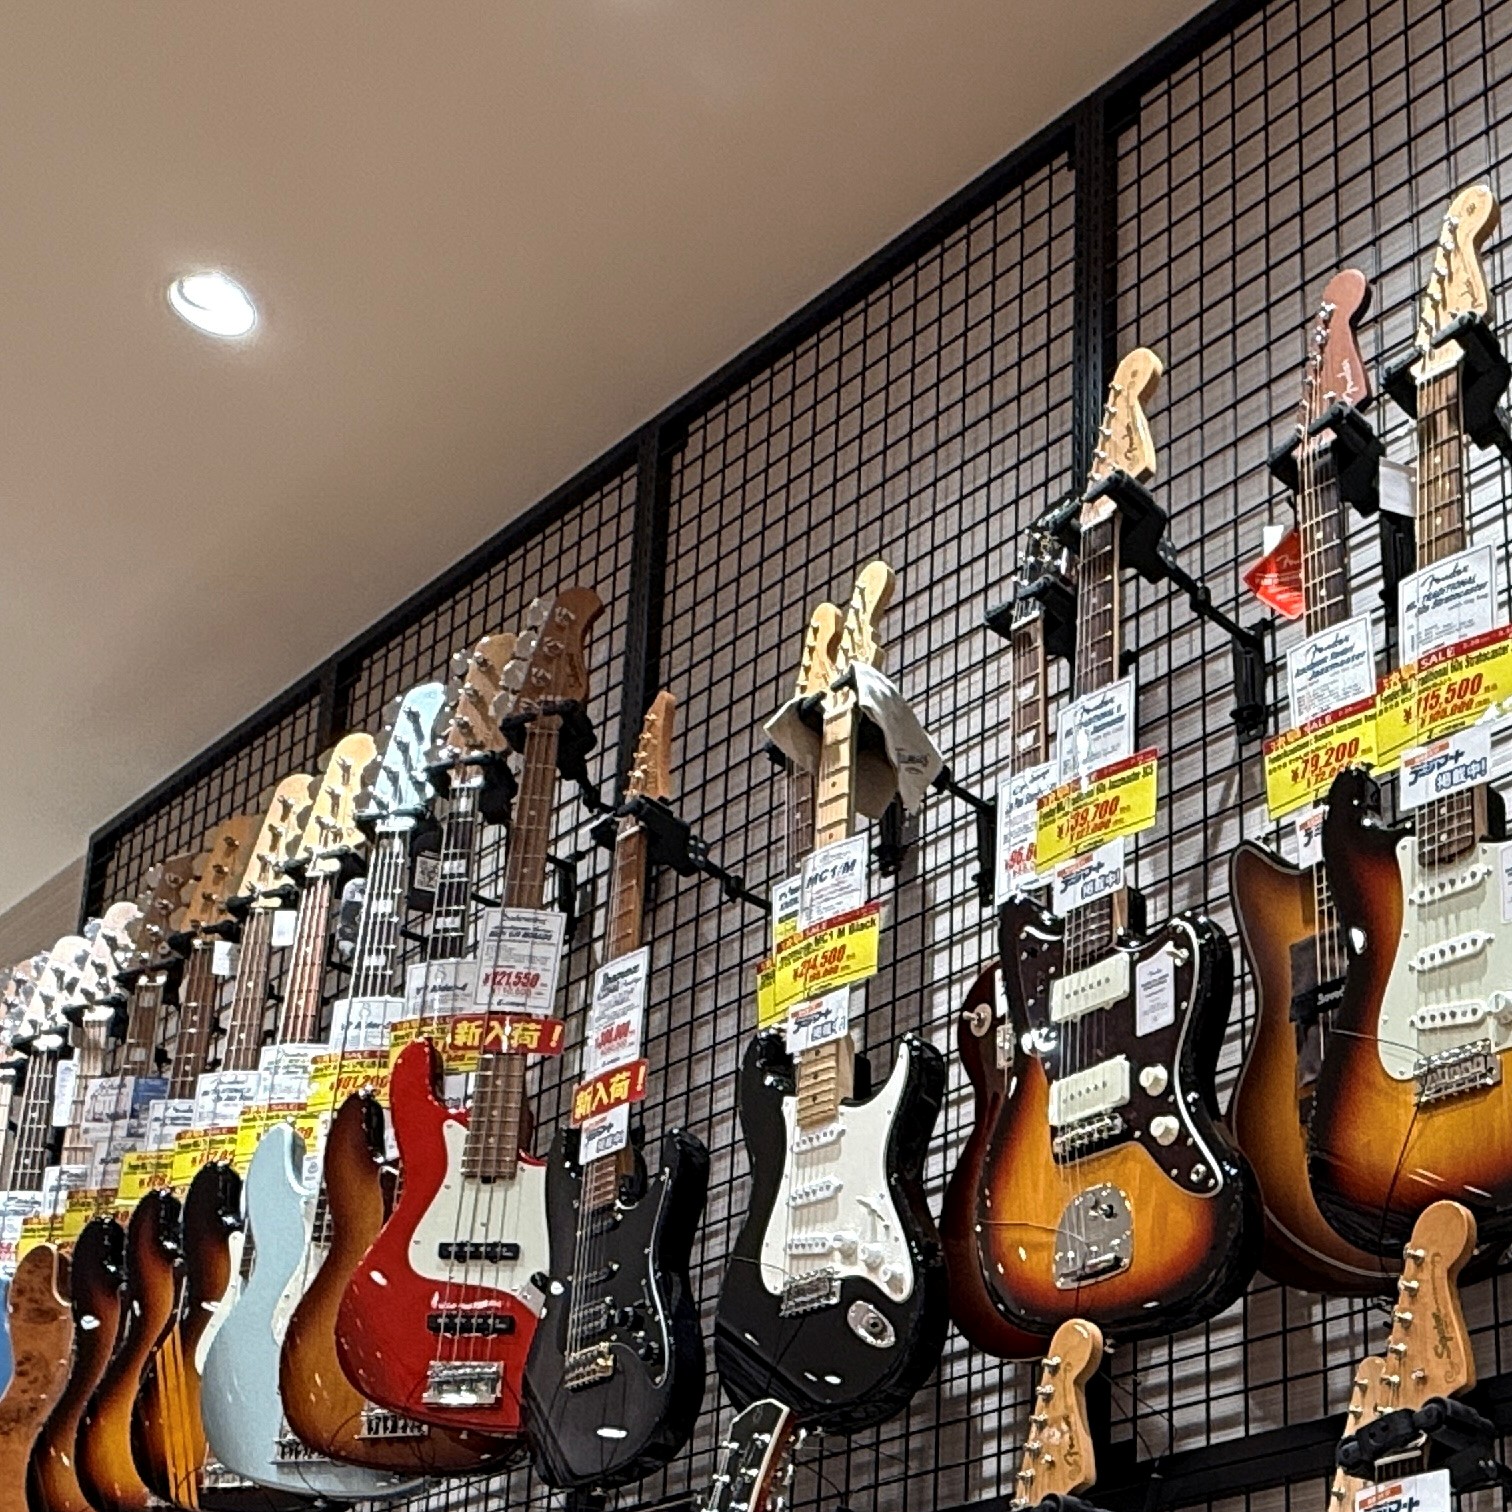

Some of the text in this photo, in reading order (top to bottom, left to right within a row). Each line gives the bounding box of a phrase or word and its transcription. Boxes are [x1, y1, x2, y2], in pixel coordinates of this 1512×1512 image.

[1420, 647, 1456, 669] SALE
[1291, 736, 1361, 785] ¥79,200
[455, 1021, 563, 1050] 新入荷!
[575, 1064, 646, 1121] 新入荷!
